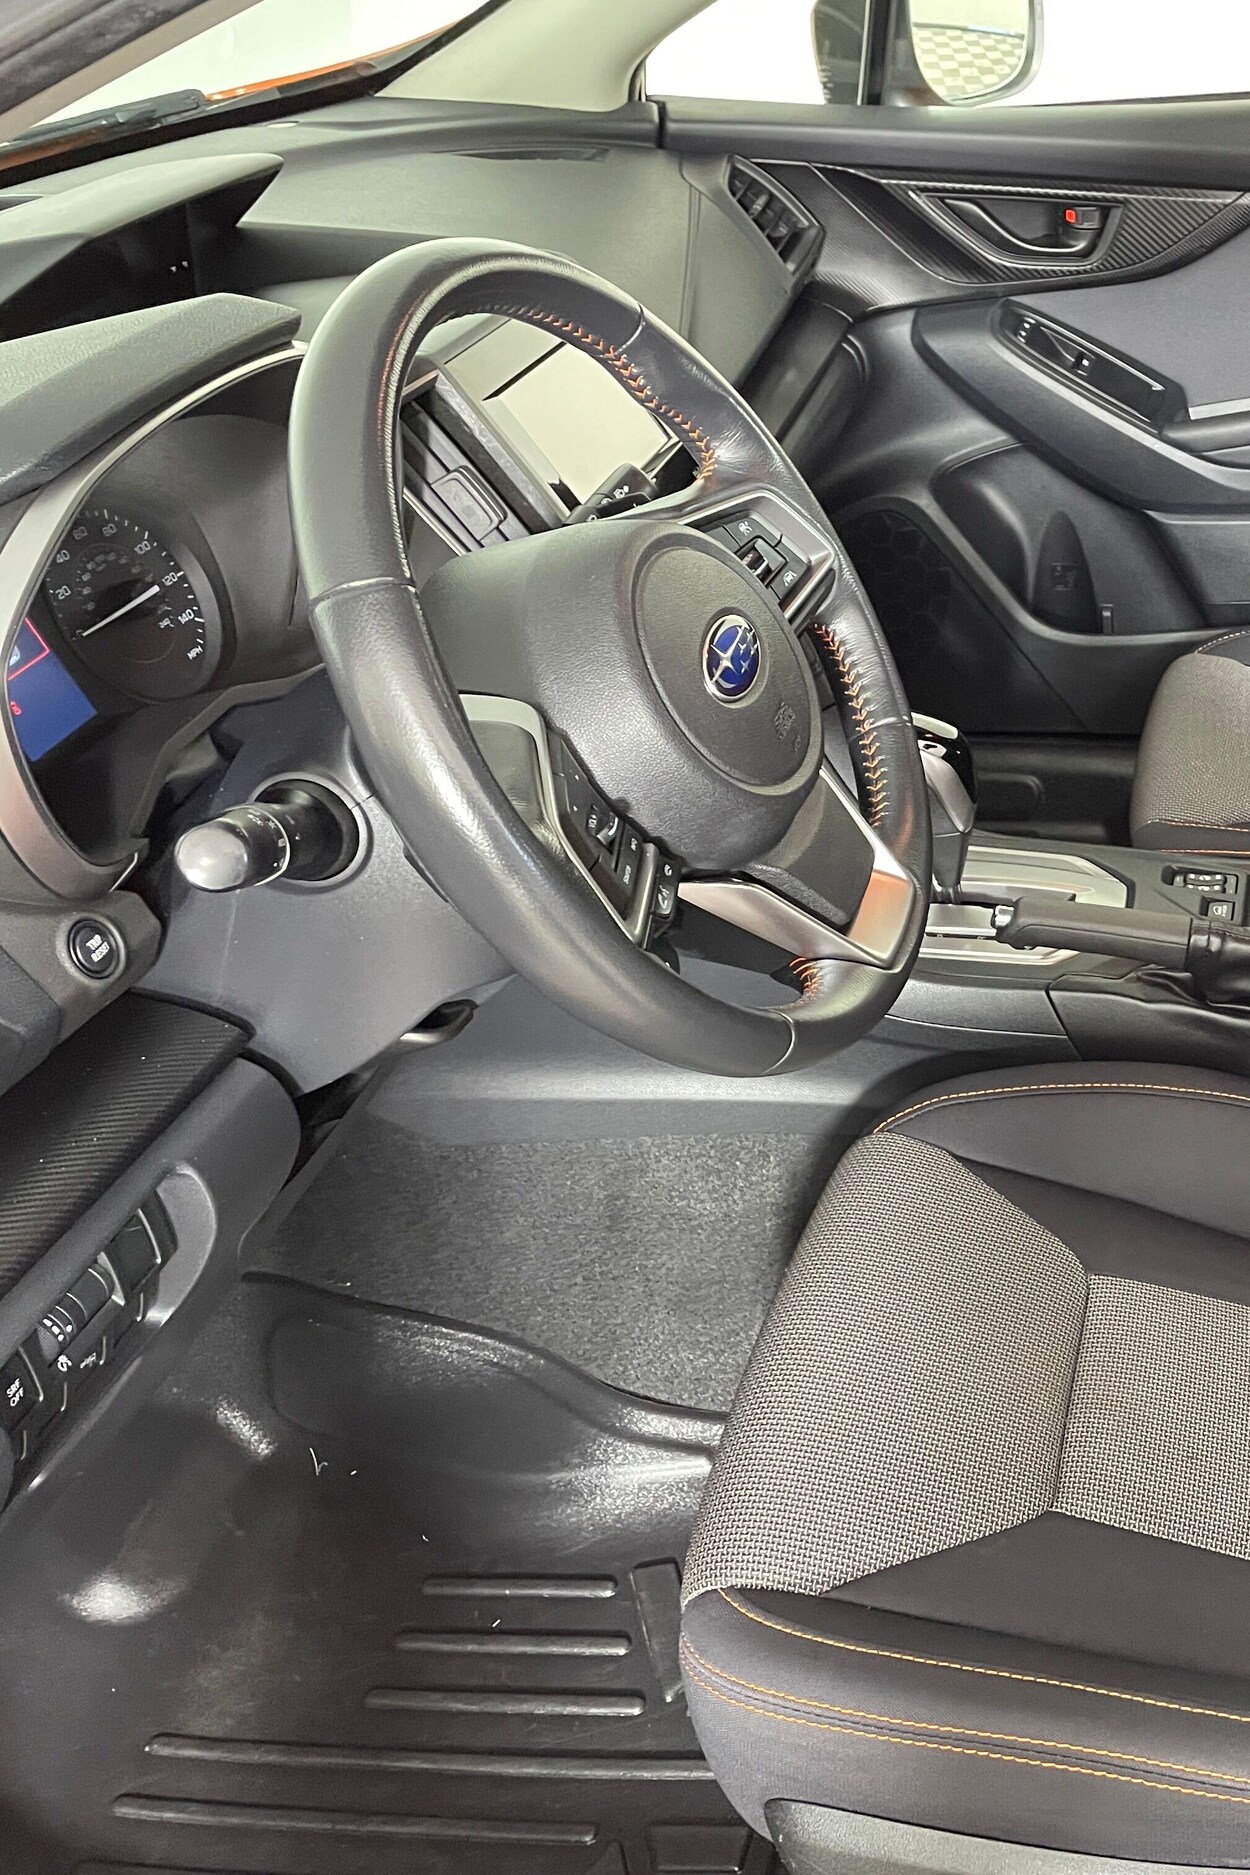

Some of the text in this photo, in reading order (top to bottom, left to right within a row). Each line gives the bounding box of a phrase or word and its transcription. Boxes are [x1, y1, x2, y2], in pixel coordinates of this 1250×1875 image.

[102, 524, 116, 536] 80
[134, 540, 150, 554] 100
[56, 550, 70, 563] 40
[162, 572, 178, 586] 120
[56, 585, 70, 600] 20
[178, 609, 194, 624] 140
[187, 645, 203, 660] MPH
[6, 1378, 20, 1397] SRF
[10, 1387, 24, 1407] OFF
